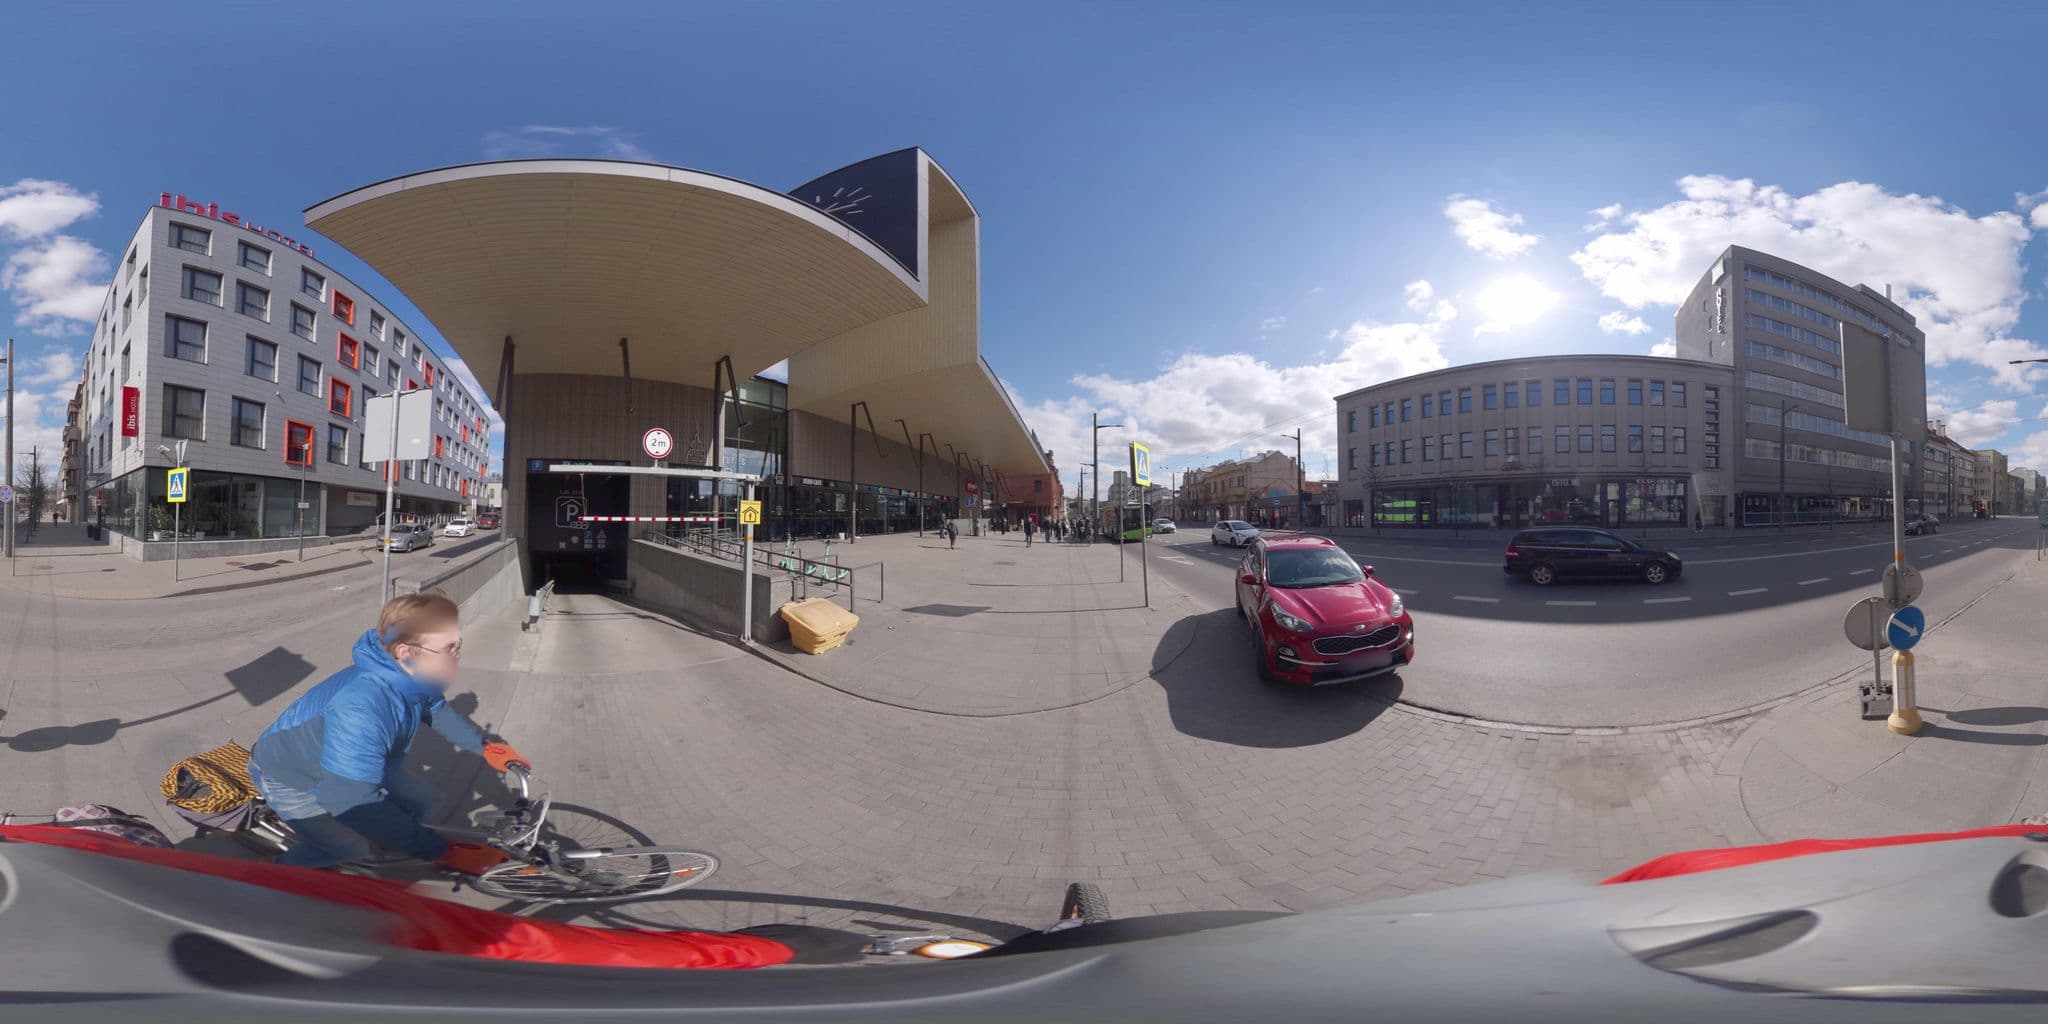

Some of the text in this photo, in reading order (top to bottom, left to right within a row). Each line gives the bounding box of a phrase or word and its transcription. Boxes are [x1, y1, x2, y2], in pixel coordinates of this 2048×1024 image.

[161, 192, 315, 258] ibis HOTEL
[127, 414, 136, 430] ibis
